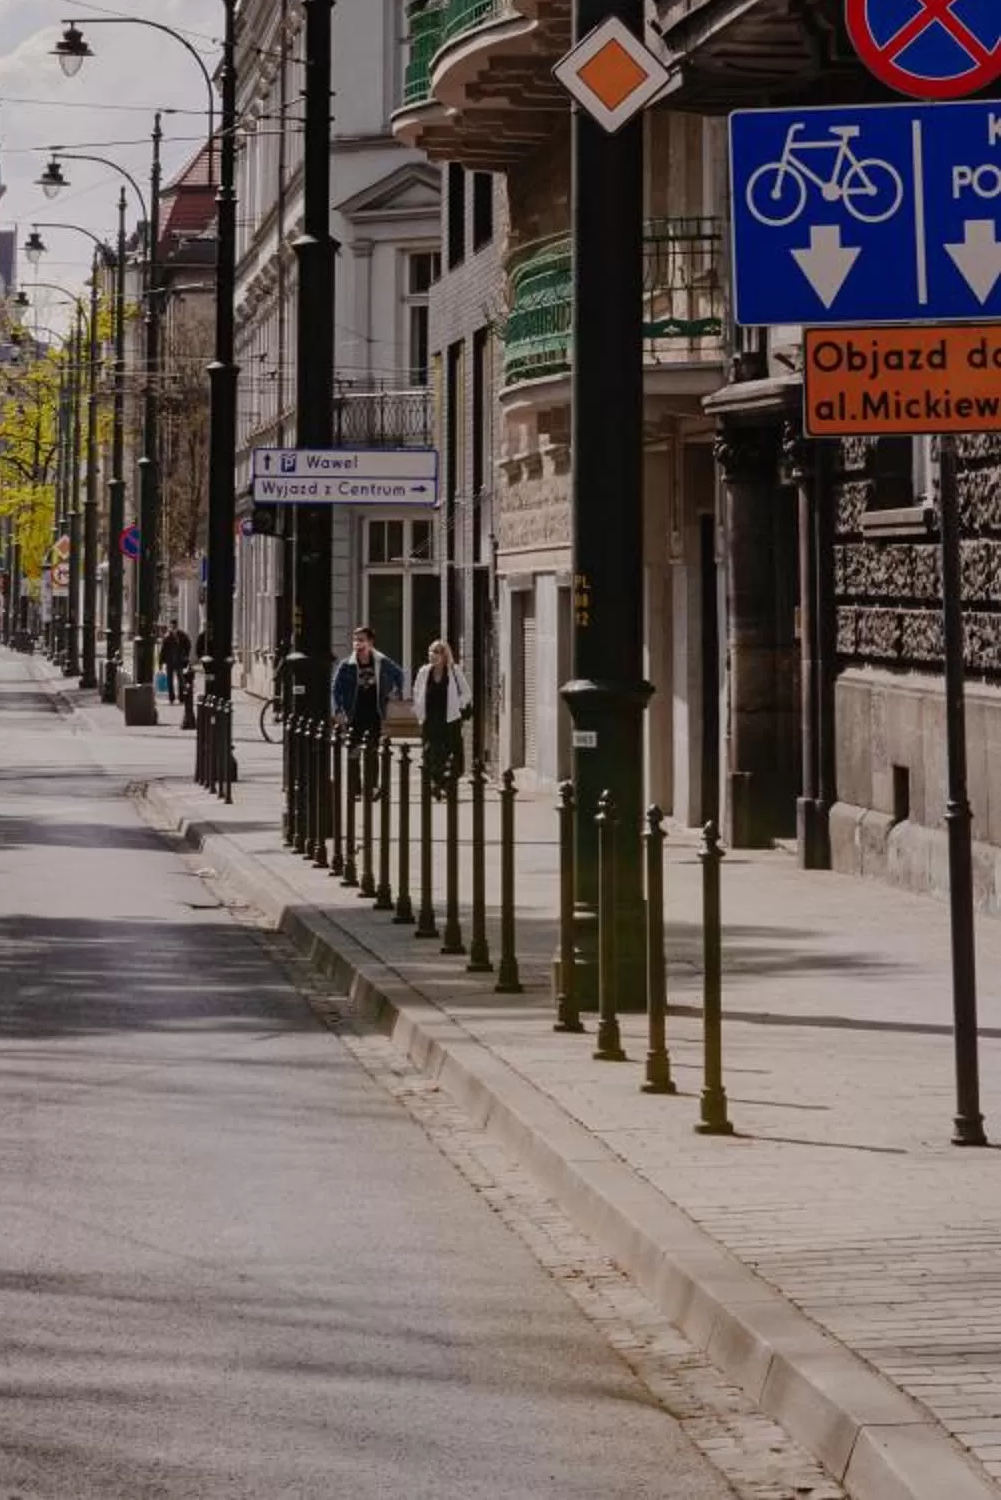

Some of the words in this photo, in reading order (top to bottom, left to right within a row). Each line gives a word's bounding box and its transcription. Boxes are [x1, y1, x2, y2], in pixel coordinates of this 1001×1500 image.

[813, 339, 947, 381] Objazd
[306, 453, 359, 470] Wawel
[262, 480, 318, 498] Wyjazd
[324, 485, 332, 496] z
[338, 480, 406, 497] Centrum
